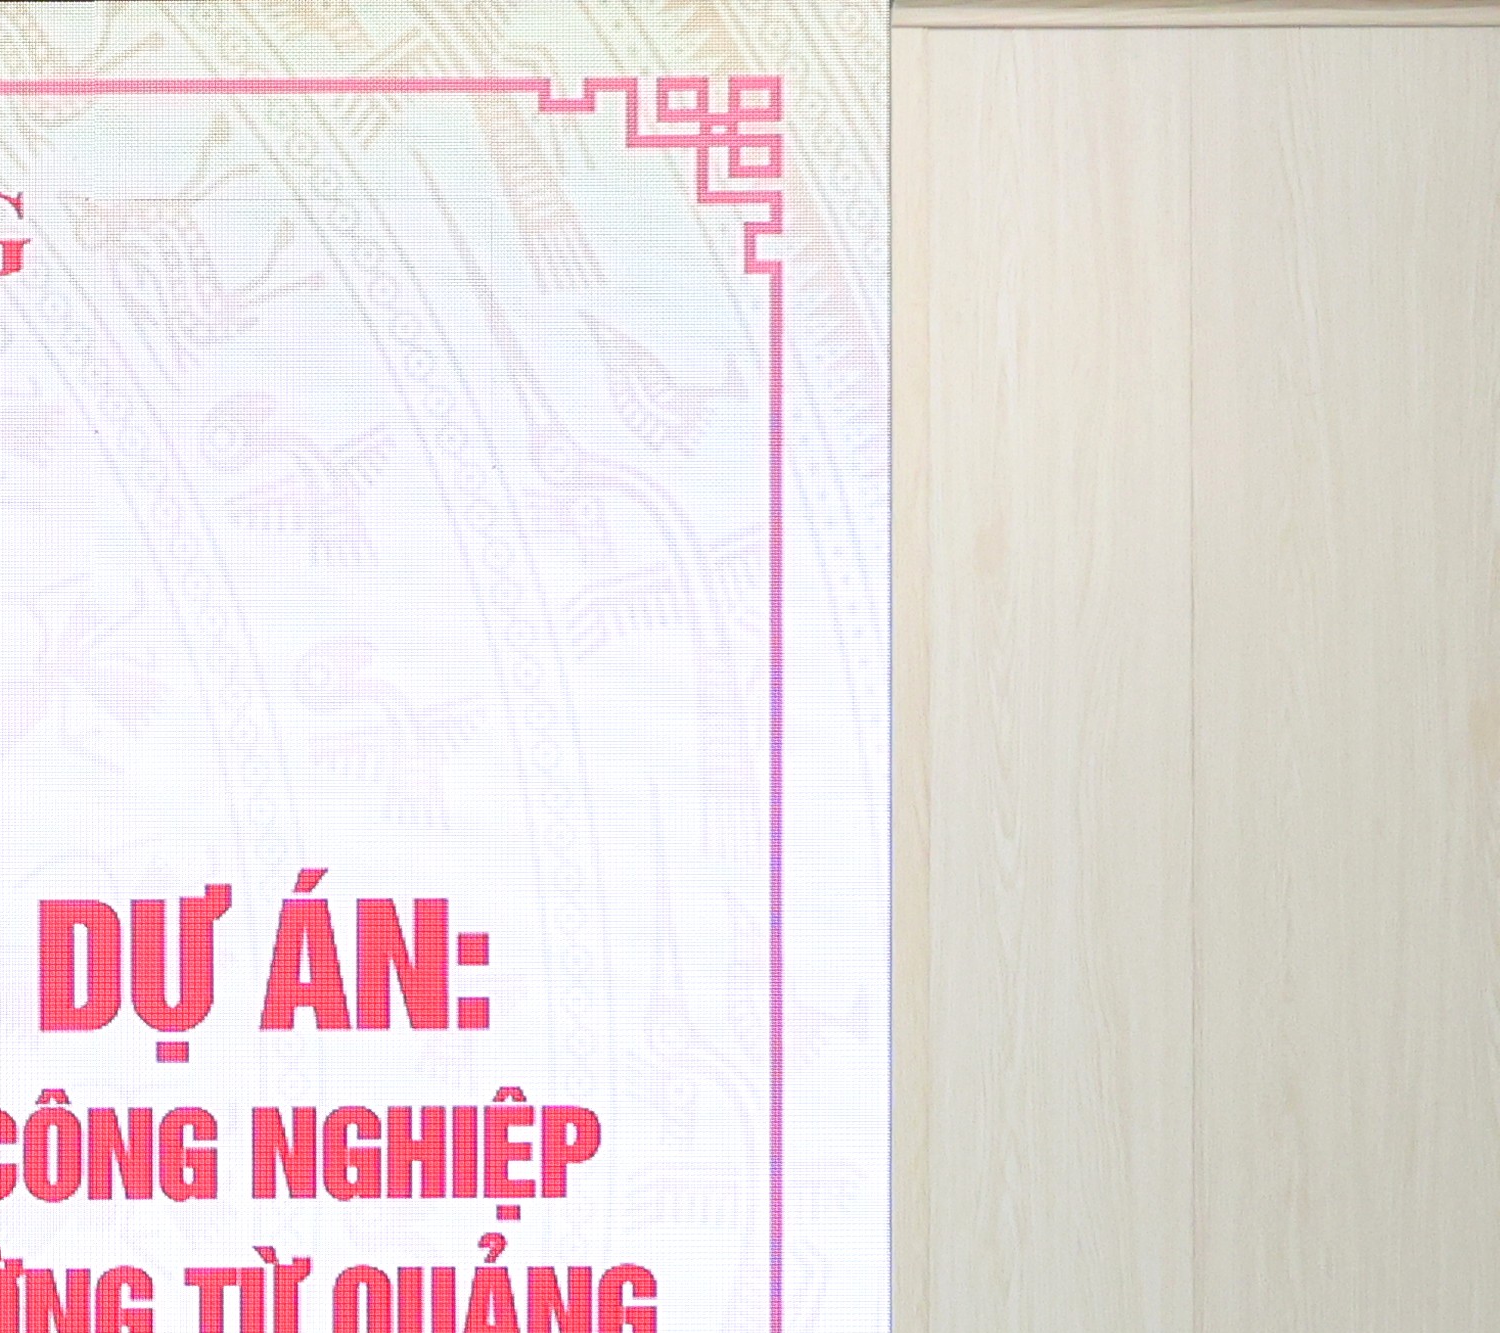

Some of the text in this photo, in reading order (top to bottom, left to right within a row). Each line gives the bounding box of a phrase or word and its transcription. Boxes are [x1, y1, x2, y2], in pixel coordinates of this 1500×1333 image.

[39, 884, 232, 1062] DỰ
[261, 868, 490, 1031] ÁN:
[253, 1086, 601, 1221] NGHIỆP
